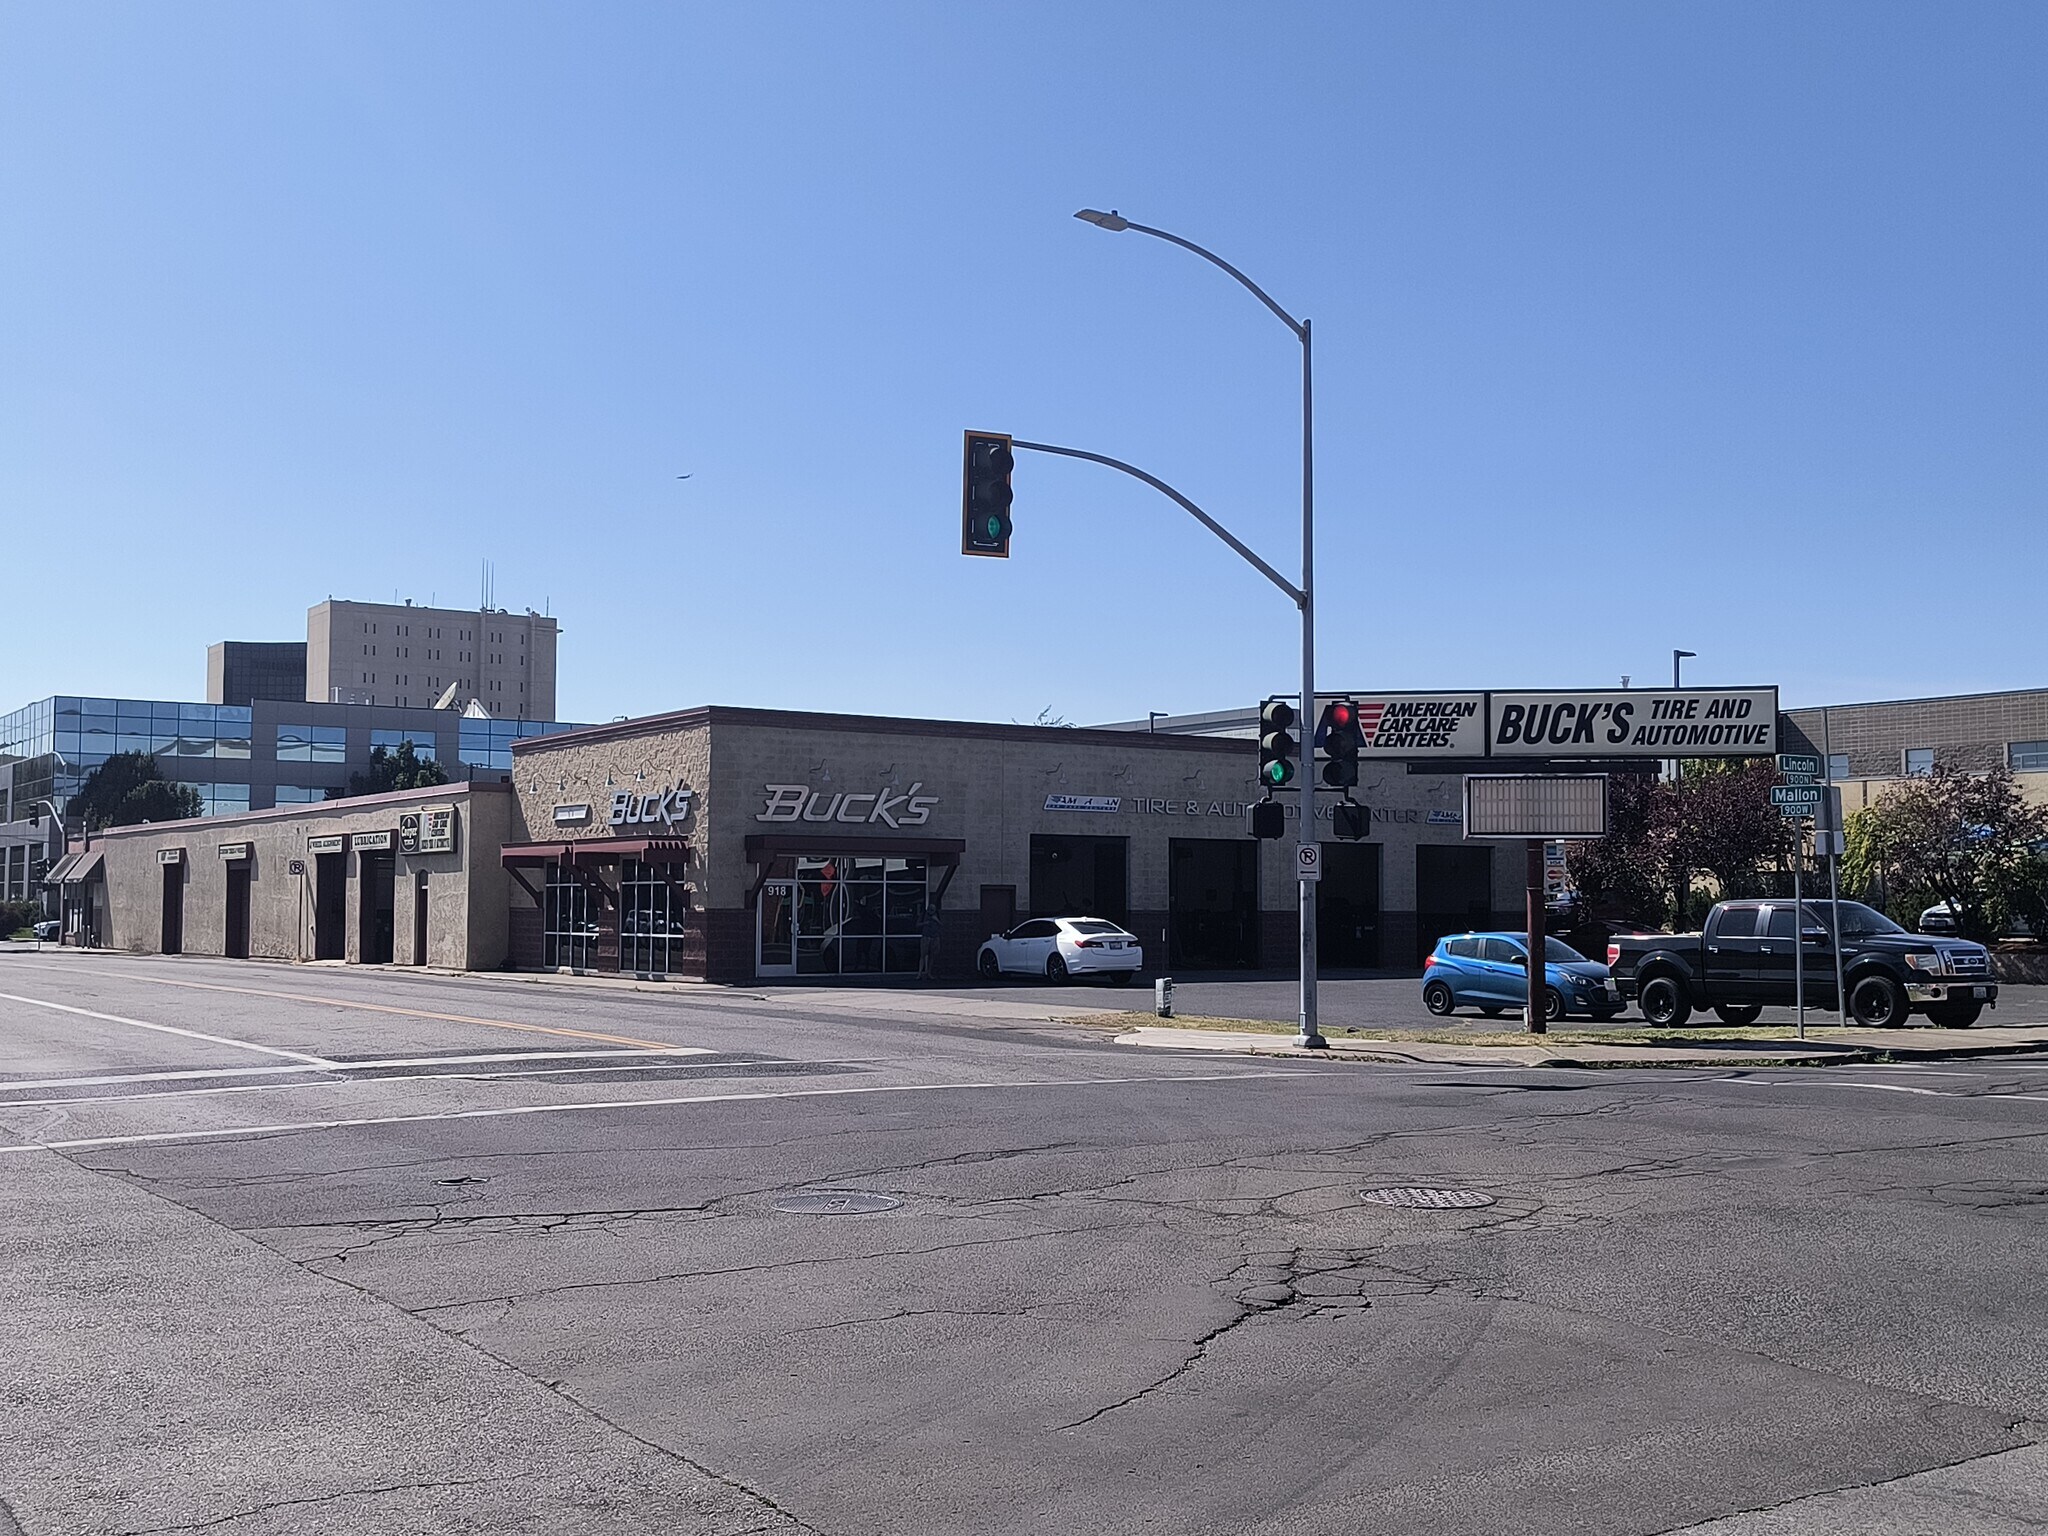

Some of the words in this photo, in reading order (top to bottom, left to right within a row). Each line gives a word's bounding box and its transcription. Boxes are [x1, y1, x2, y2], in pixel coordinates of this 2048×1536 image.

[1383, 702, 1478, 717] AMERICAN
[1651, 699, 1699, 720] TIRE
[1704, 699, 1752, 719] AND
[1378, 717, 1414, 733] CAR
[1414, 717, 1460, 732] CARE
[1496, 702, 1634, 745] BUCK'S
[1631, 723, 1771, 746] AUTOMOTIVE
[1782, 757, 1815, 772] Lincoln
[1789, 775, 1809, 784] 900N
[608, 778, 692, 826] BUCK'S
[1775, 788, 1818, 802] Mallon
[755, 782, 940, 829] BUCK'S
[1133, 797, 1178, 815] TIRE
[1186, 799, 1200, 816] &
[1784, 805, 1809, 815] 900W
[767, 885, 787, 897] 918
